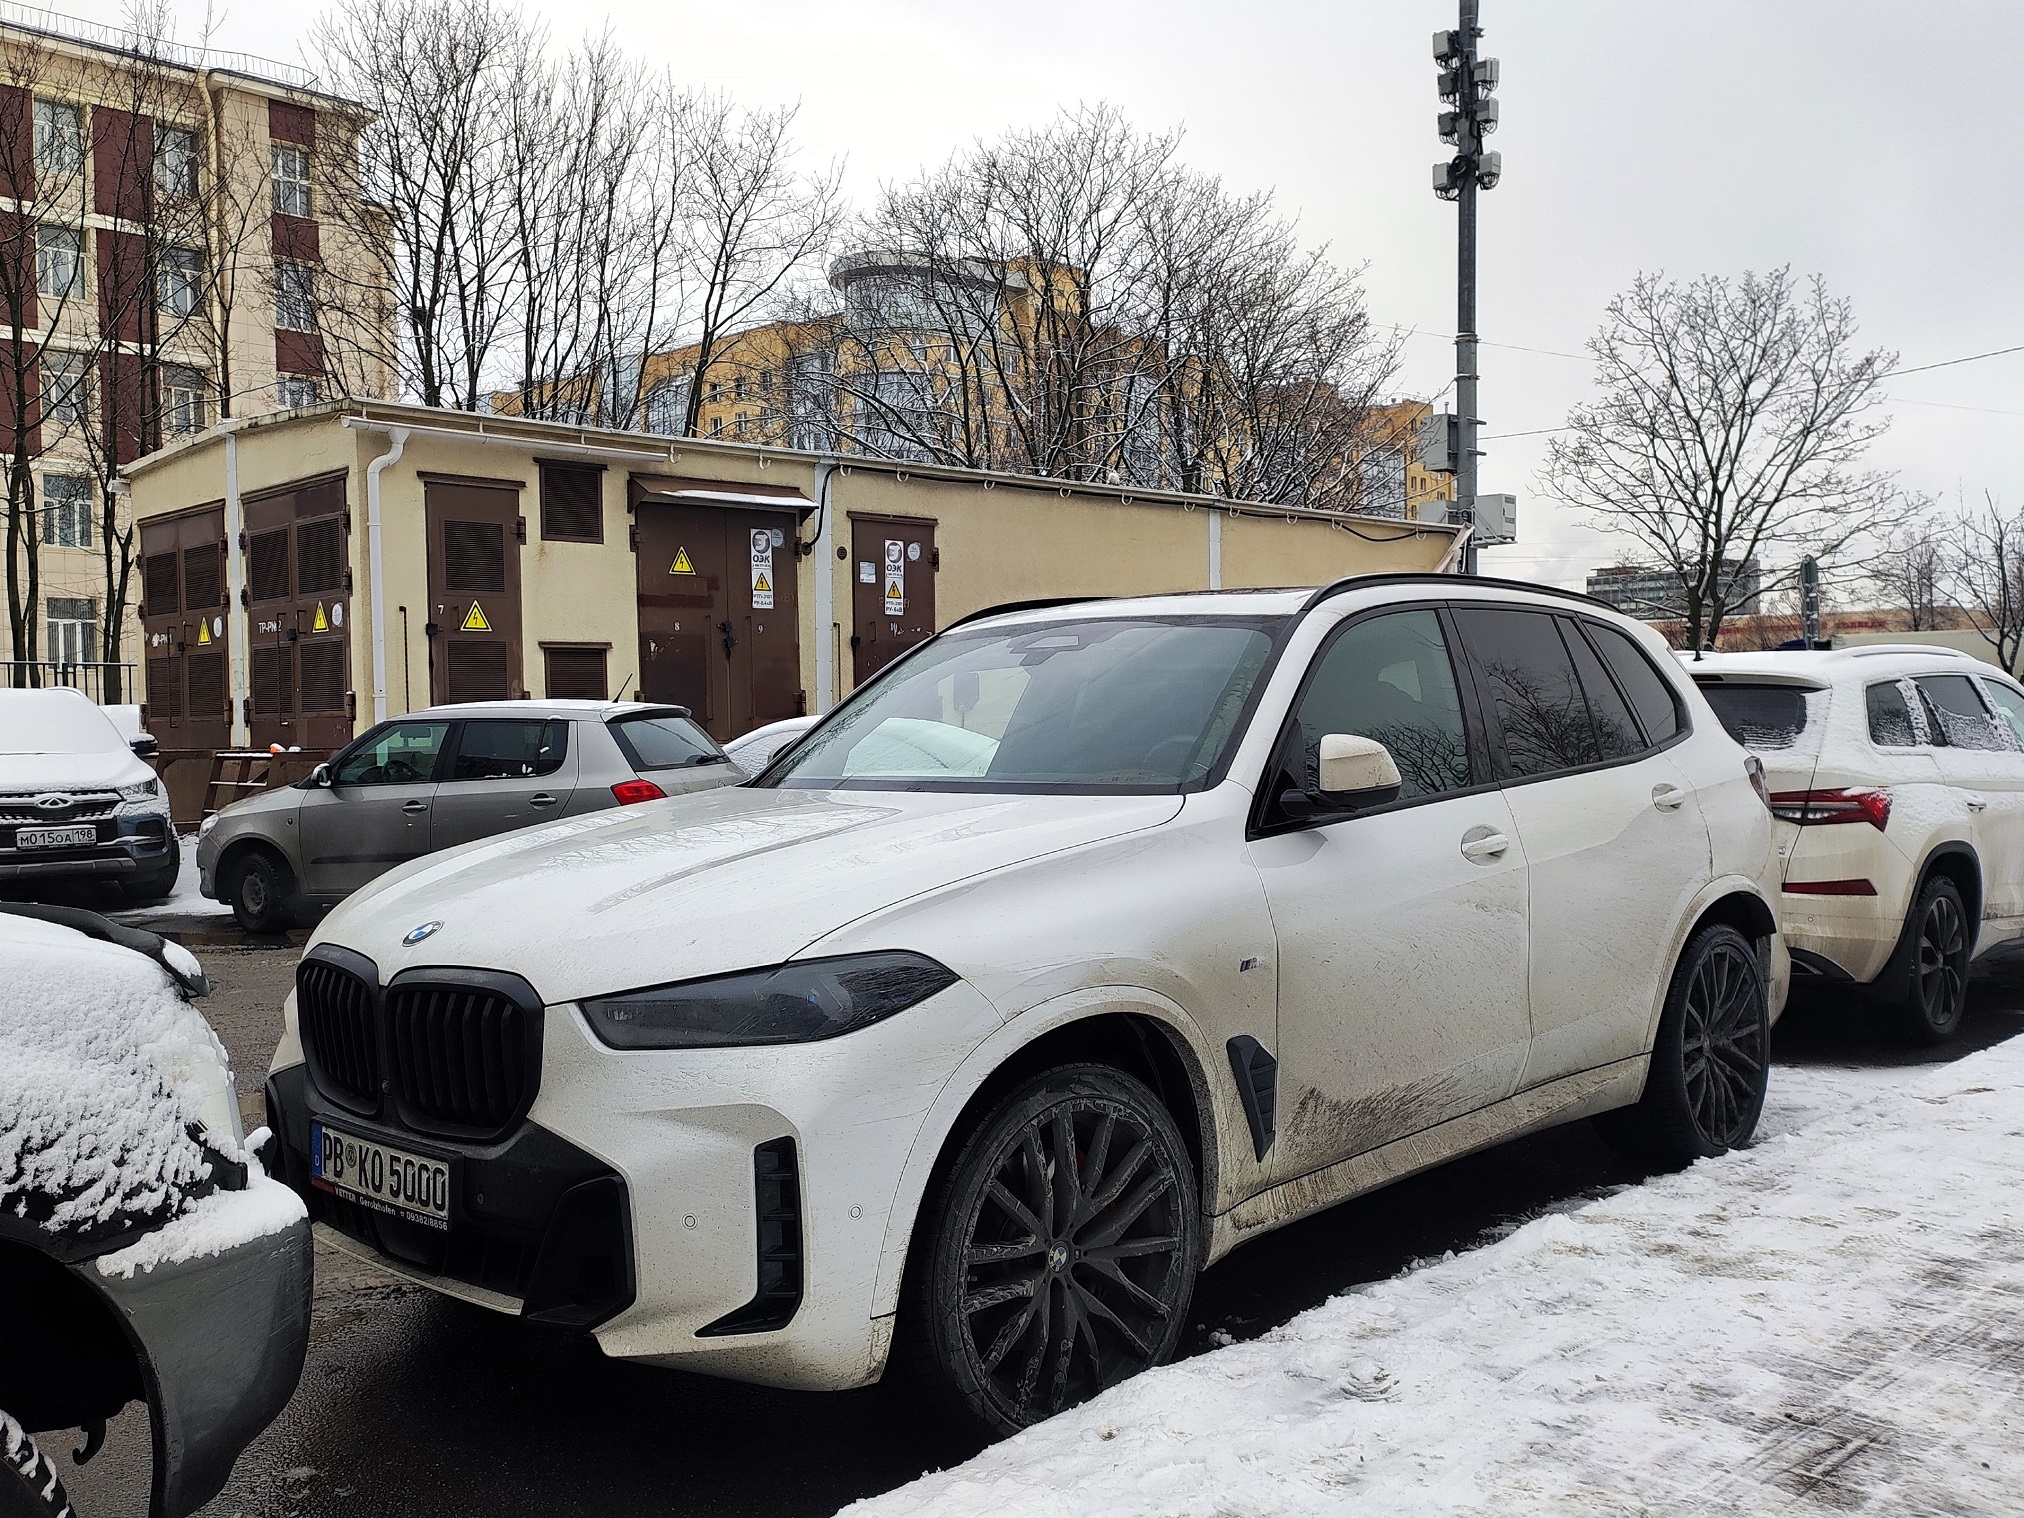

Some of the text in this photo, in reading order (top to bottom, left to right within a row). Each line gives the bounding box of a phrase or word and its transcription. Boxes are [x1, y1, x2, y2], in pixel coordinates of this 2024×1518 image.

[752, 554, 770, 563] ОЭК
[886, 564, 902, 573] ОЭК
[437, 605, 444, 615] 7
[674, 622, 680, 632] 8
[758, 625, 764, 634] 9
[20, 829, 93, 846] М015ОА 198
[315, 1155, 320, 1167] D
[323, 1132, 447, 1212] PB KO 5000
[334, 1185, 356, 1202] VETTER
[359, 1196, 396, 1216] Gerolzhofen
